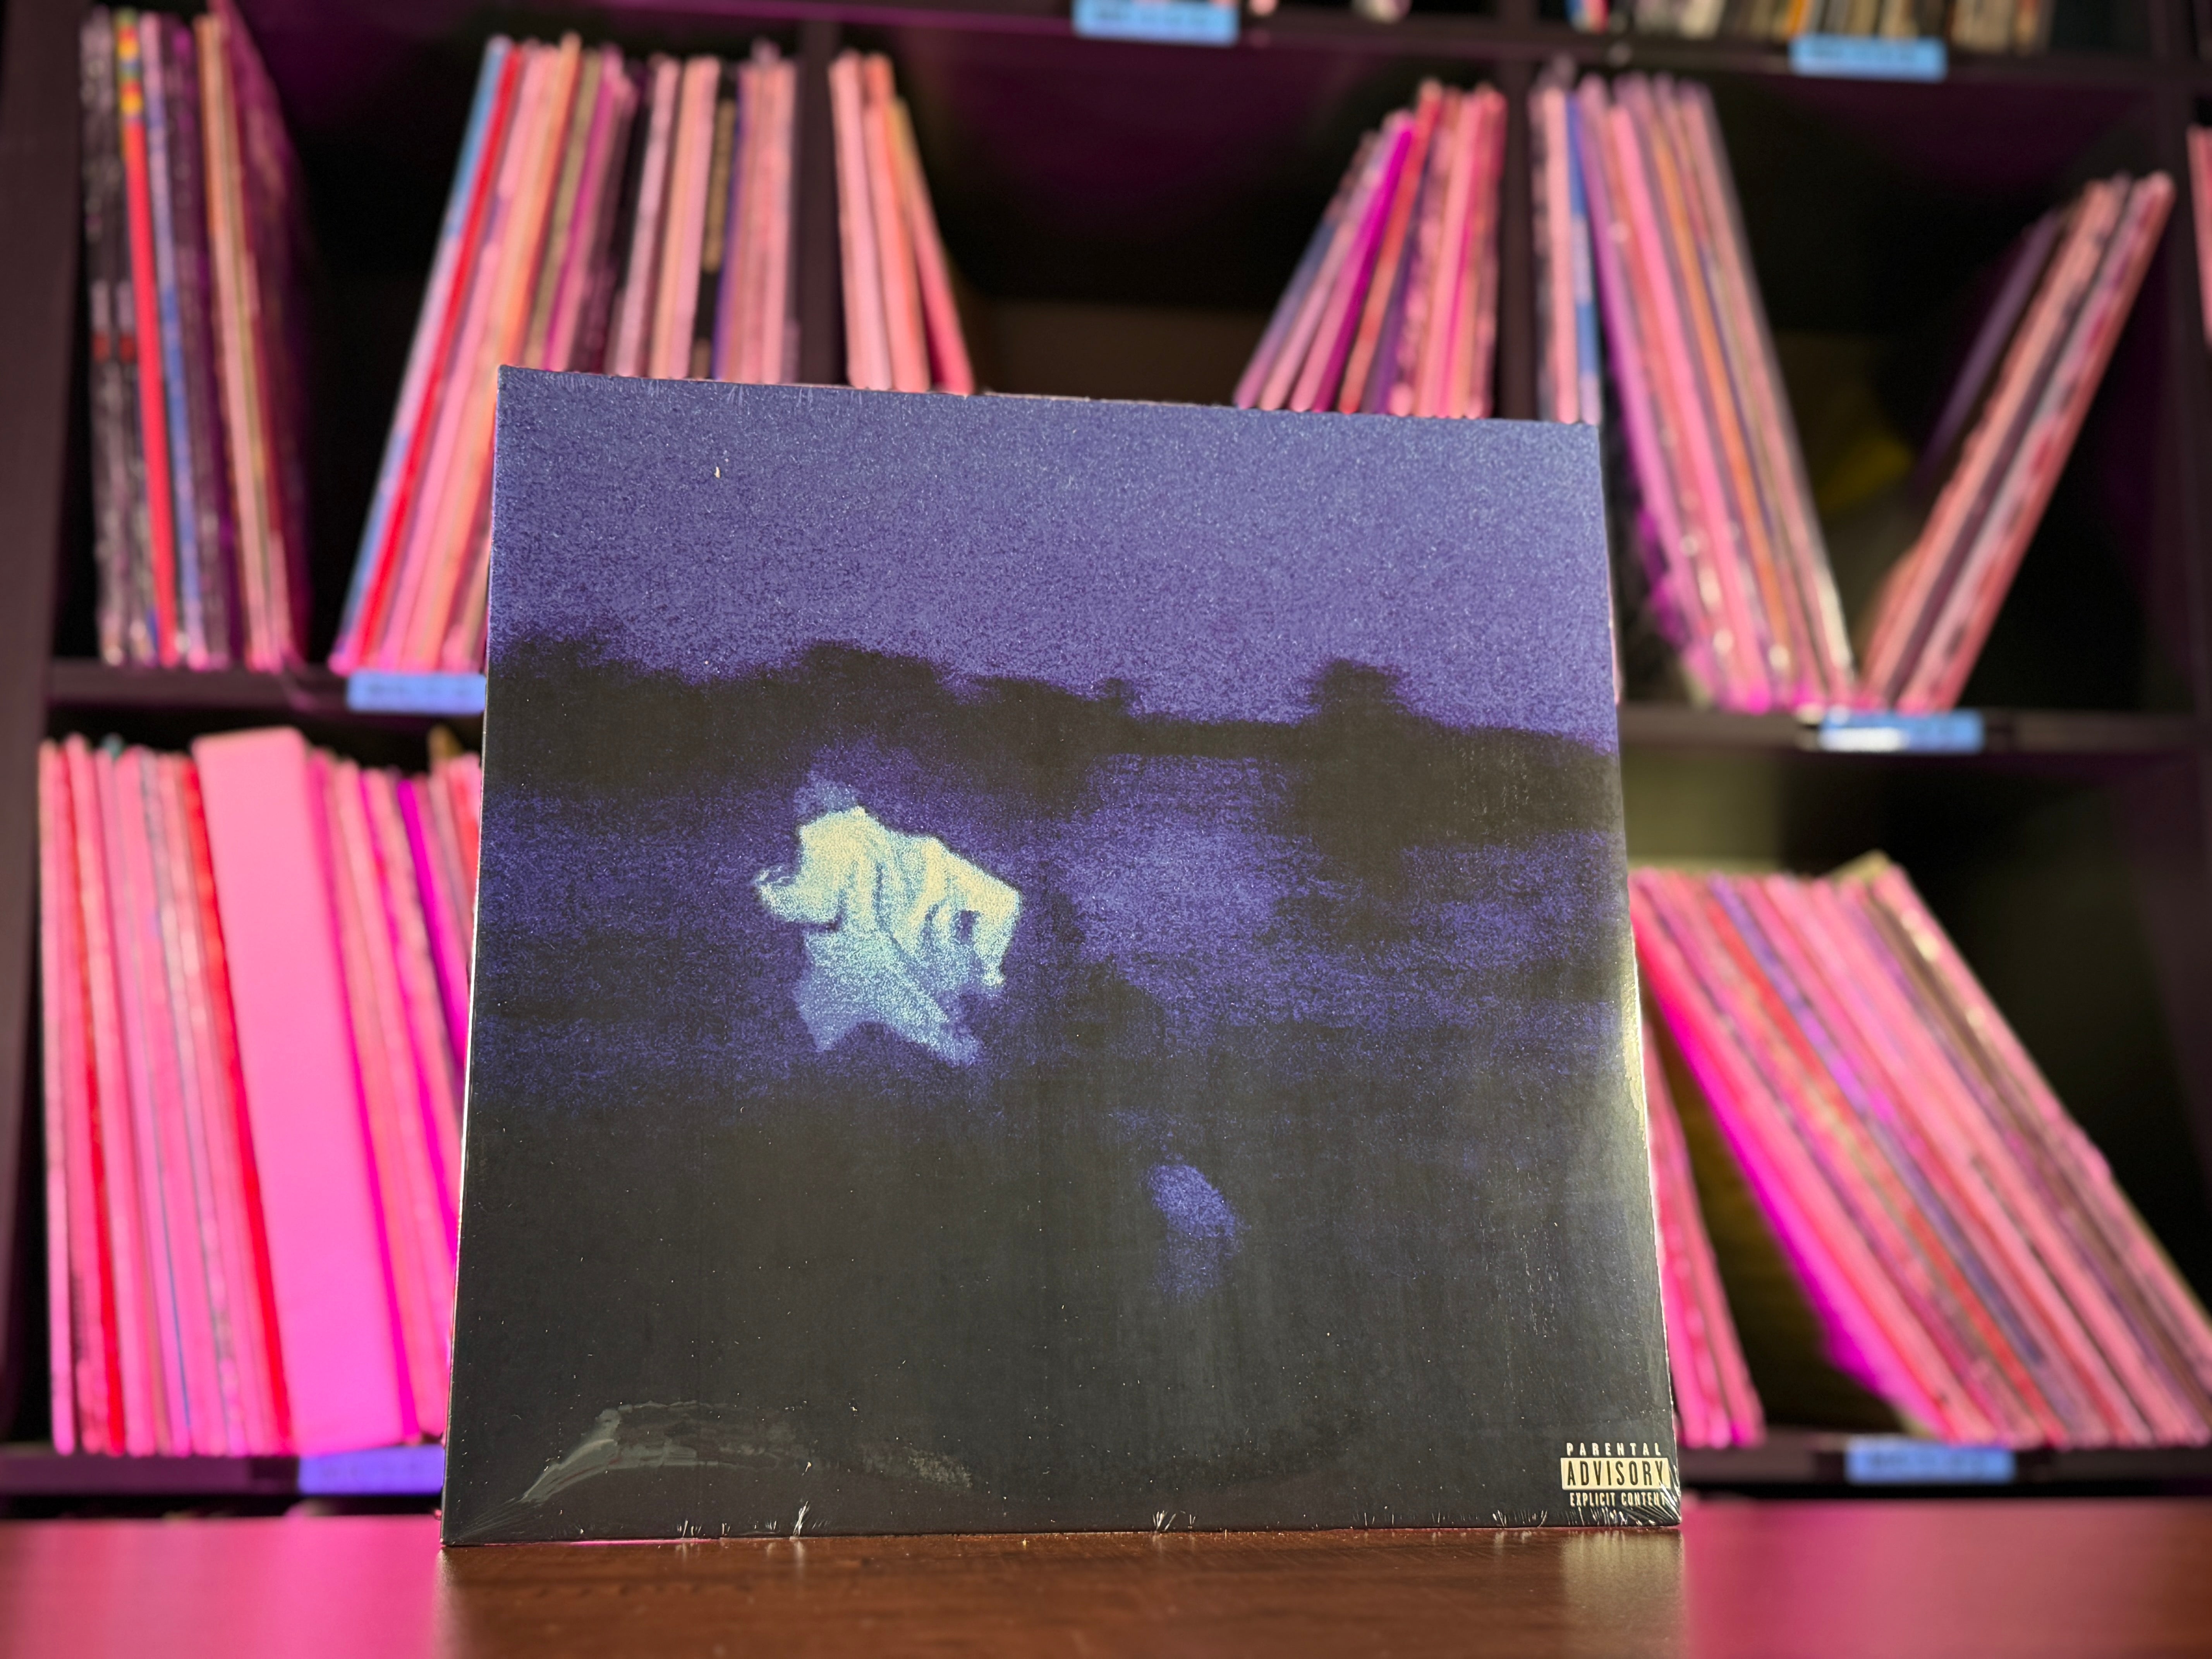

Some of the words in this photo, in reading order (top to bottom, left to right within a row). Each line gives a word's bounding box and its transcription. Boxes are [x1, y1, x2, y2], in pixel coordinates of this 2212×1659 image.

[1566, 1443, 1661, 1456] PARENTAL
[1567, 1460, 1664, 1486] ADVISORY
[1570, 1492, 1615, 1507] EXPLICIT
[1621, 1492, 1666, 1506] CONTENT
